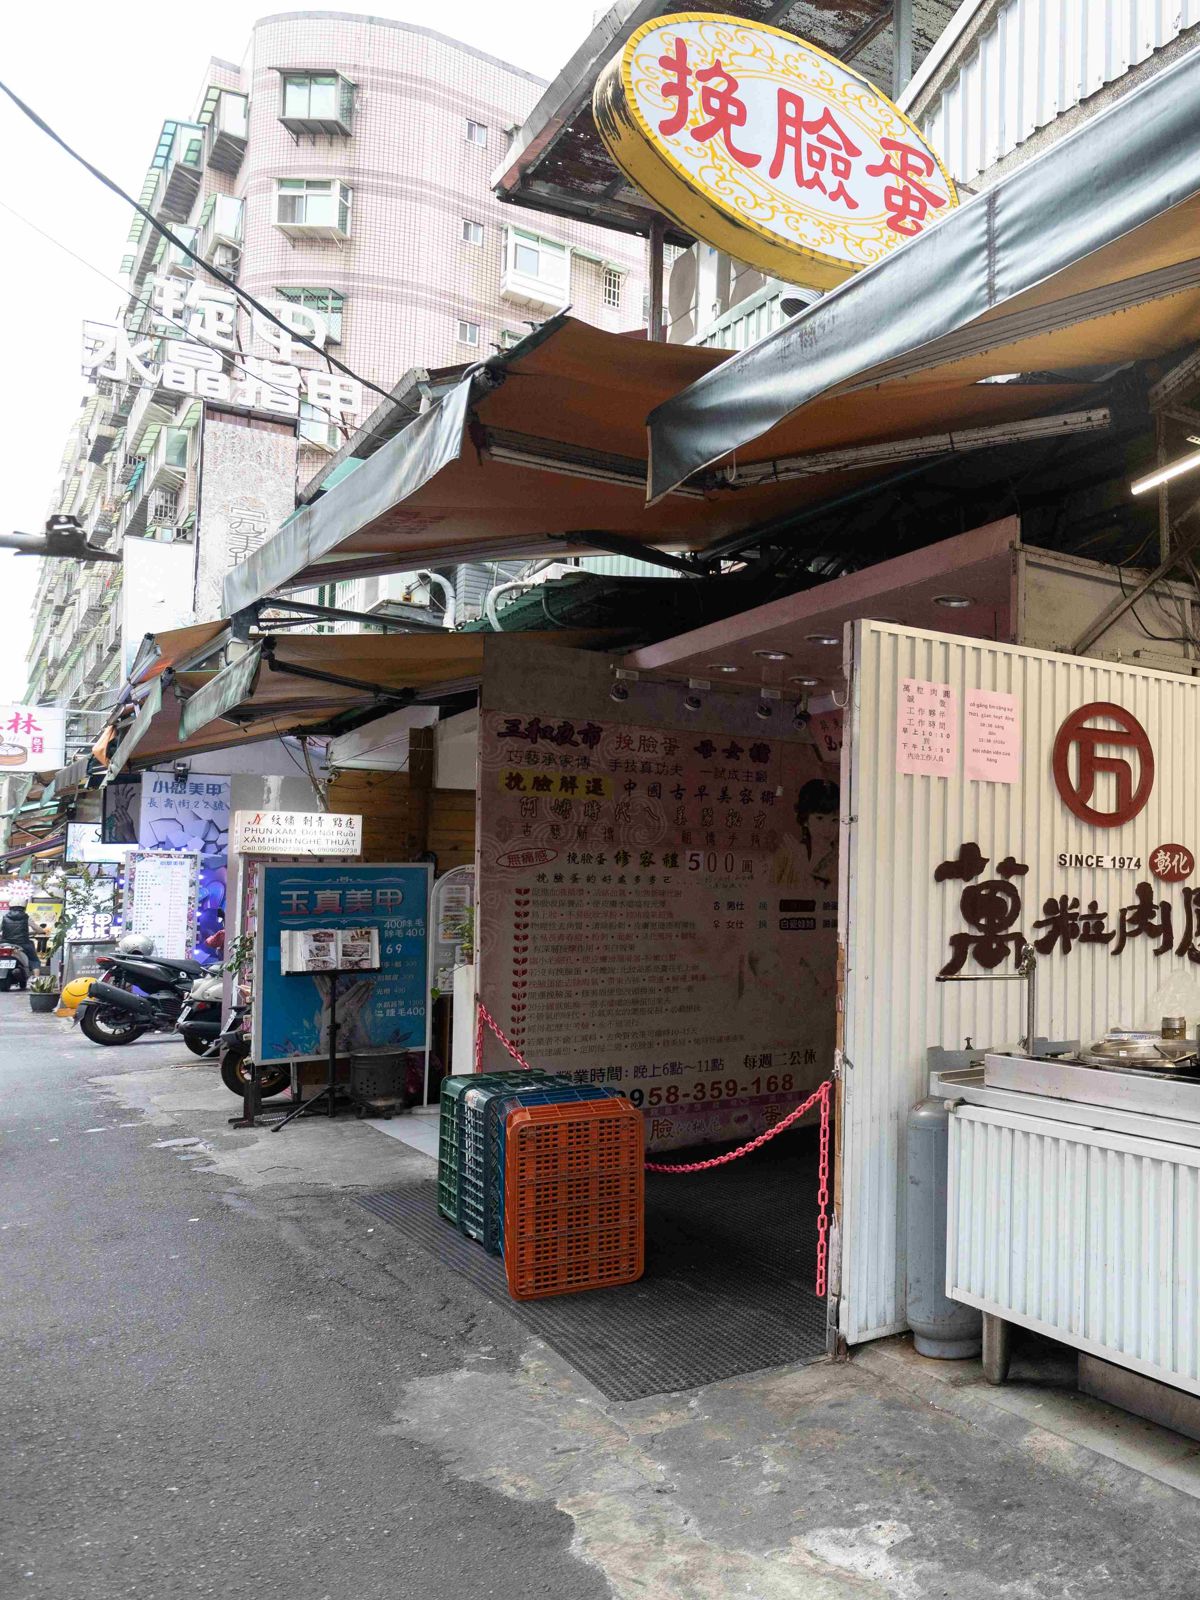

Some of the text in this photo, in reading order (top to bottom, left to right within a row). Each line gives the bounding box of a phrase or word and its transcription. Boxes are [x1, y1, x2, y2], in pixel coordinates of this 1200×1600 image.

[658, 37, 948, 237] 挽臉蛋
[906, 718, 946, 730] 工作時間
[497, 717, 604, 750] 三和夜市
[615, 733, 681, 756] 挽臉蛋
[244, 827, 273, 835] PHUN
[1058, 853, 1142, 870] SINCE 1974
[1154, 851, 1190, 876] 彰化
[279, 888, 404, 916] 玉真美甲
[405, 928, 425, 937] 400
[743, 1048, 817, 1070] 每週二公休
[617, 1074, 794, 1108] 958-359-168
